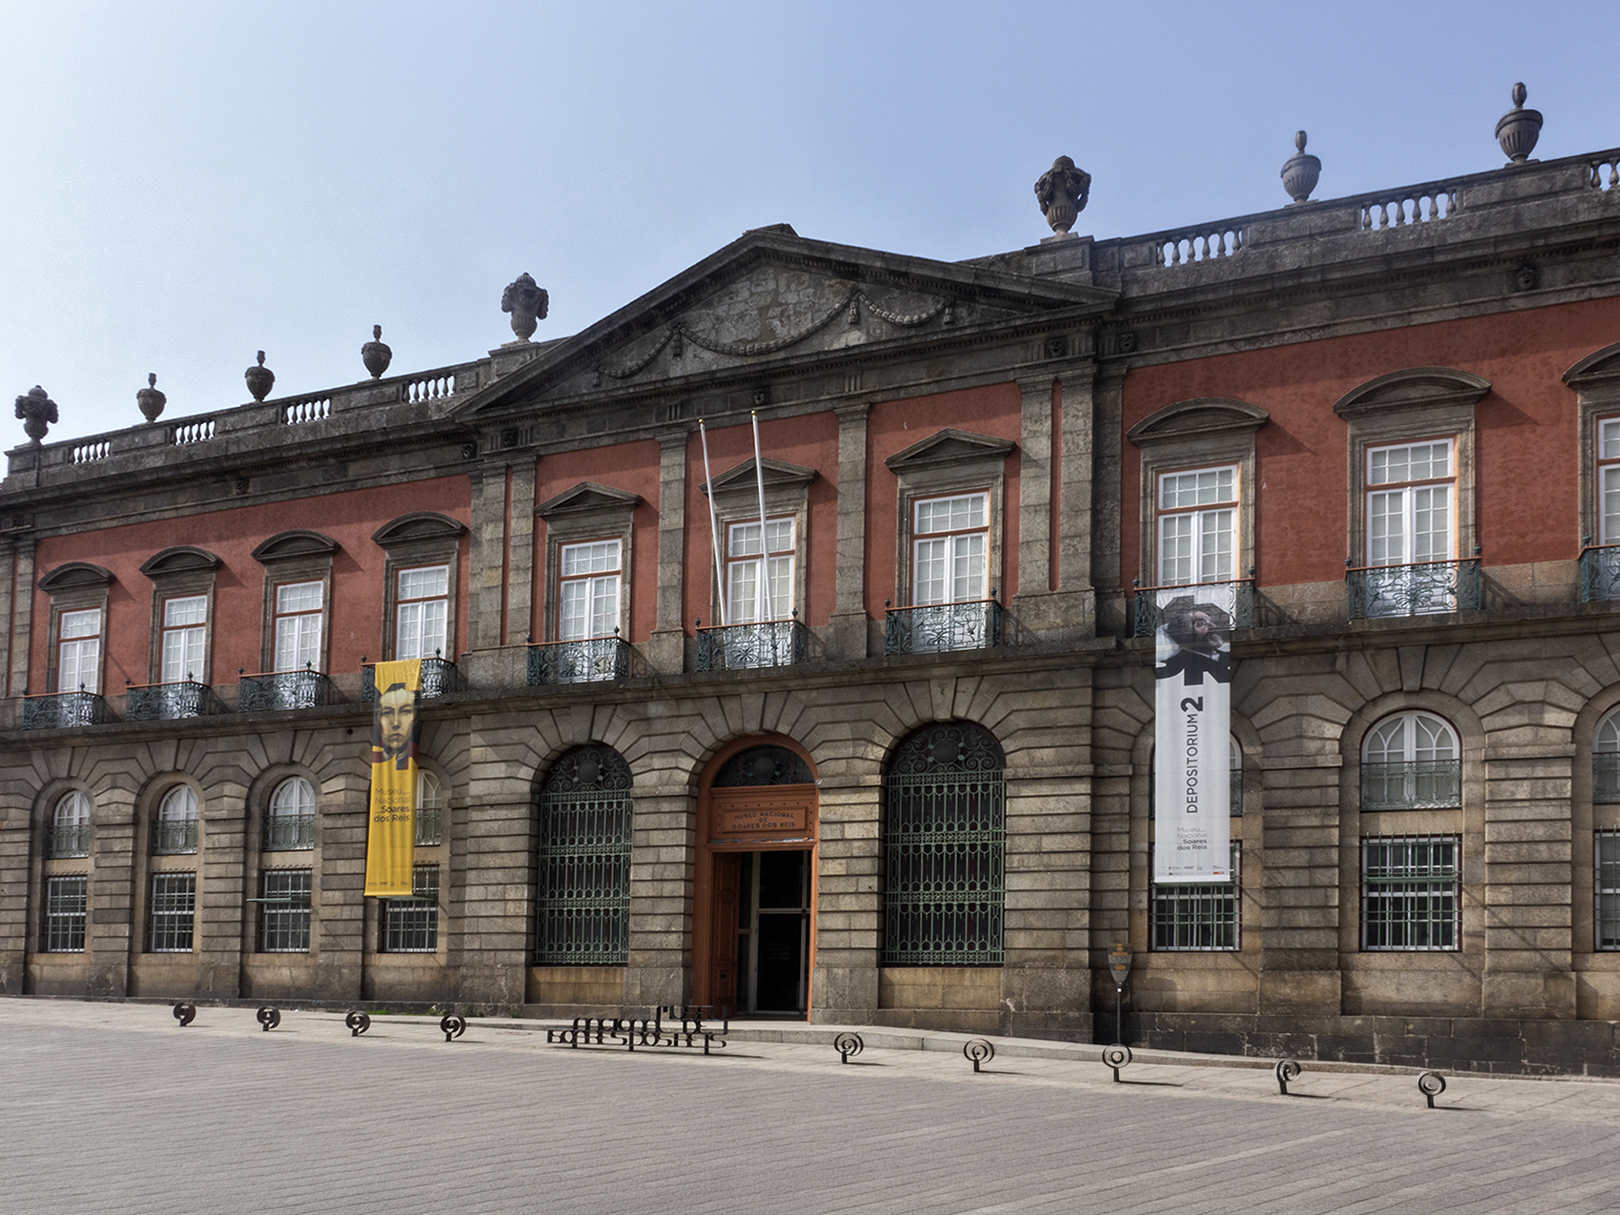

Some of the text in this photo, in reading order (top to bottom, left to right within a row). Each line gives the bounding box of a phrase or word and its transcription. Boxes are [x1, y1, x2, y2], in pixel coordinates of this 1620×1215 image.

[1180, 696, 1204, 814] DEPOSITORIUM 2
[381, 805, 410, 813] Soares
[373, 813, 410, 823] dos Reis
[734, 811, 795, 820] MUSEU NACIONAL
[732, 822, 760, 830] SOARES
[762, 821, 778, 829] DOS
